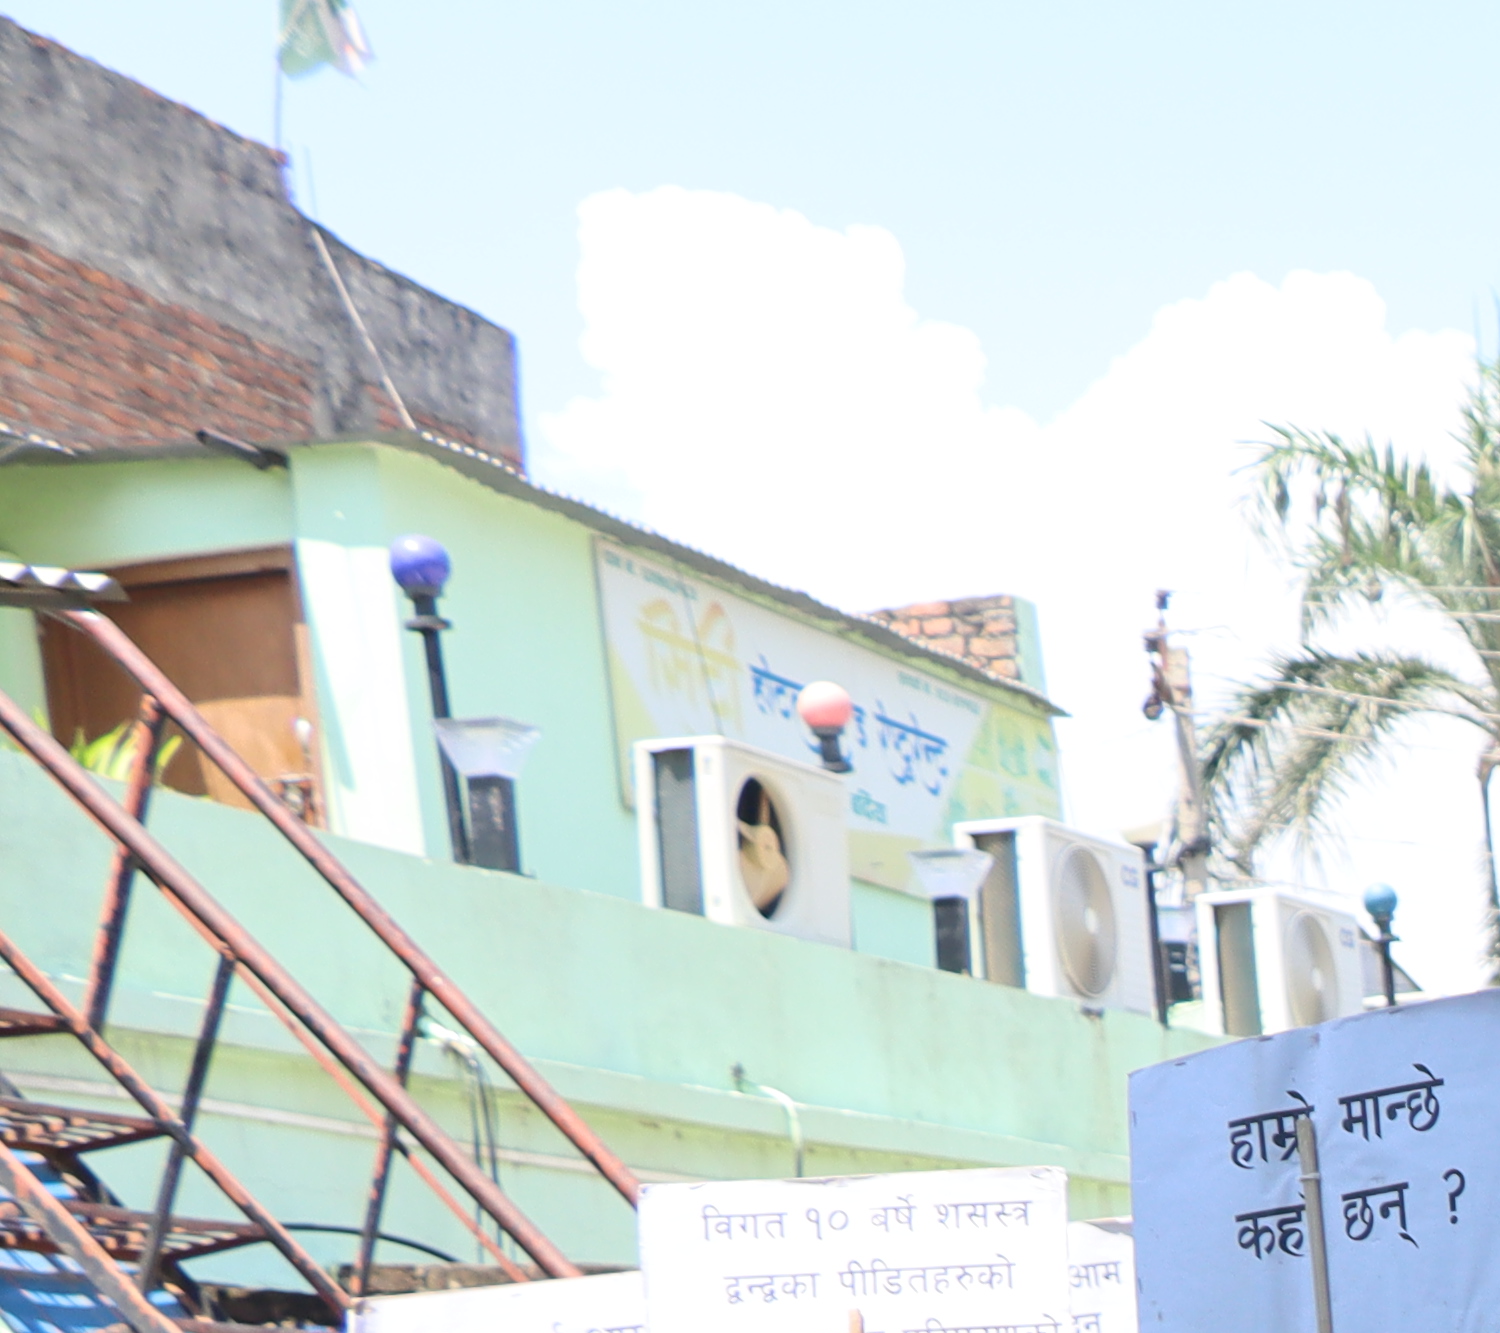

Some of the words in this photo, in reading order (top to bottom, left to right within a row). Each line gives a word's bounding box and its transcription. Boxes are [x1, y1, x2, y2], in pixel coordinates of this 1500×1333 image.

[1338, 1064, 1444, 1141] मान्छे
[701, 1204, 788, 1241] विगत
[805, 1208, 849, 1240] १०
[1342, 1182, 1419, 1248] छन्
[837, 1253, 1016, 1296] पीडितहरुको
